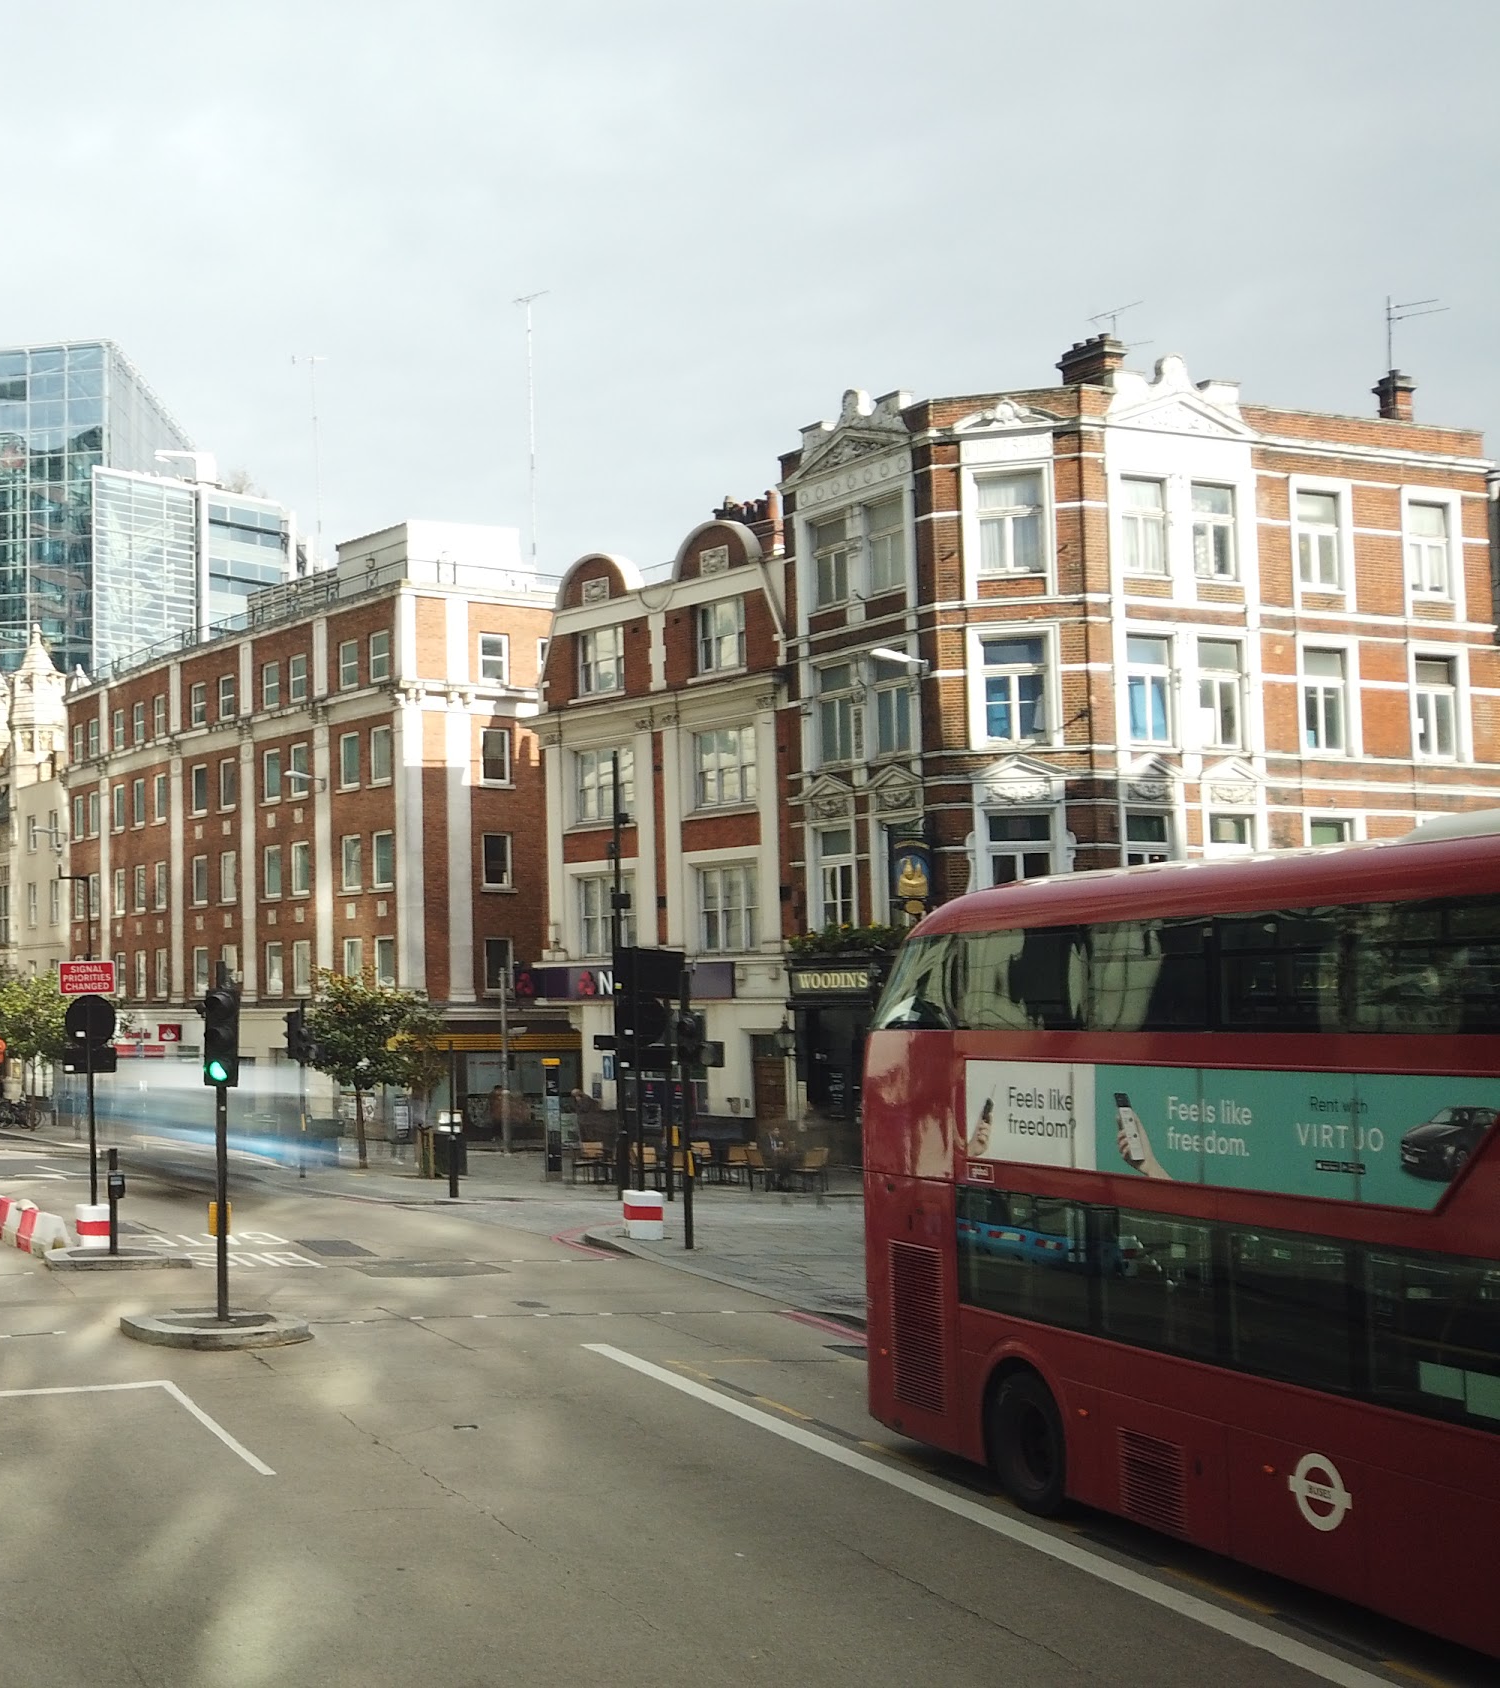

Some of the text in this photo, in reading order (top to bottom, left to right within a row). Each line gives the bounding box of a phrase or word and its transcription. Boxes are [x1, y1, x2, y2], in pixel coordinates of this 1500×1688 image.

[63, 974, 111, 982] PRIORITIES
[70, 965, 103, 973] SIGNAL
[65, 982, 110, 991] CHANGED
[1008, 1086, 1073, 1111] Feels like
[1310, 1097, 1338, 1112] Rent
[1168, 1096, 1252, 1126] Feels like
[1008, 1113, 1077, 1139] freedom?
[1168, 1126, 1250, 1157] freedom.
